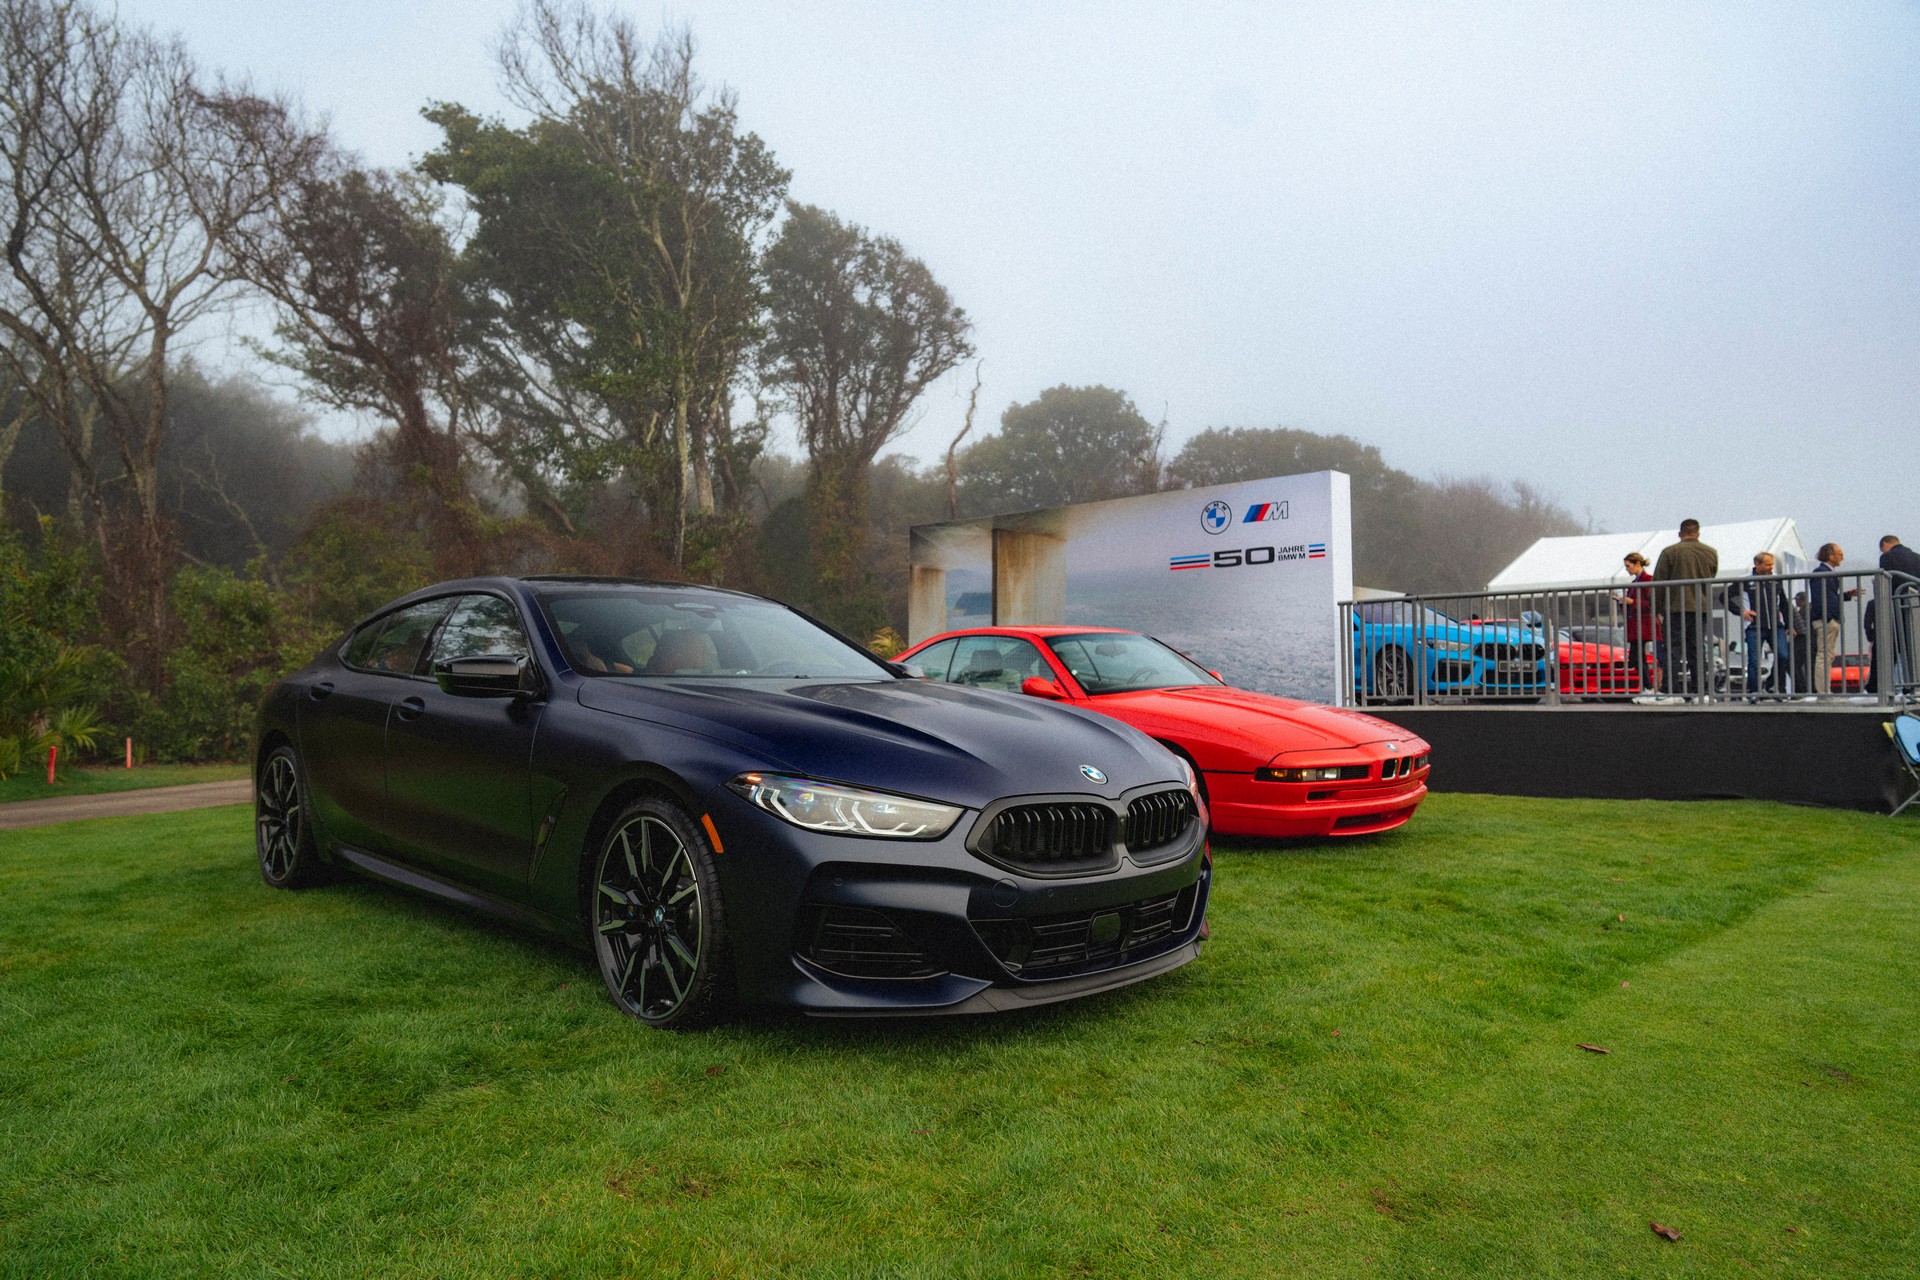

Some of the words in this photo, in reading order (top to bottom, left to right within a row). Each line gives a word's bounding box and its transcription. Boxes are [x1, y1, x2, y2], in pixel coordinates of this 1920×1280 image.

[1278, 544, 1305, 554] JAHRE
[1214, 546, 1275, 568] 50
[1278, 553, 1298, 561] BMW
